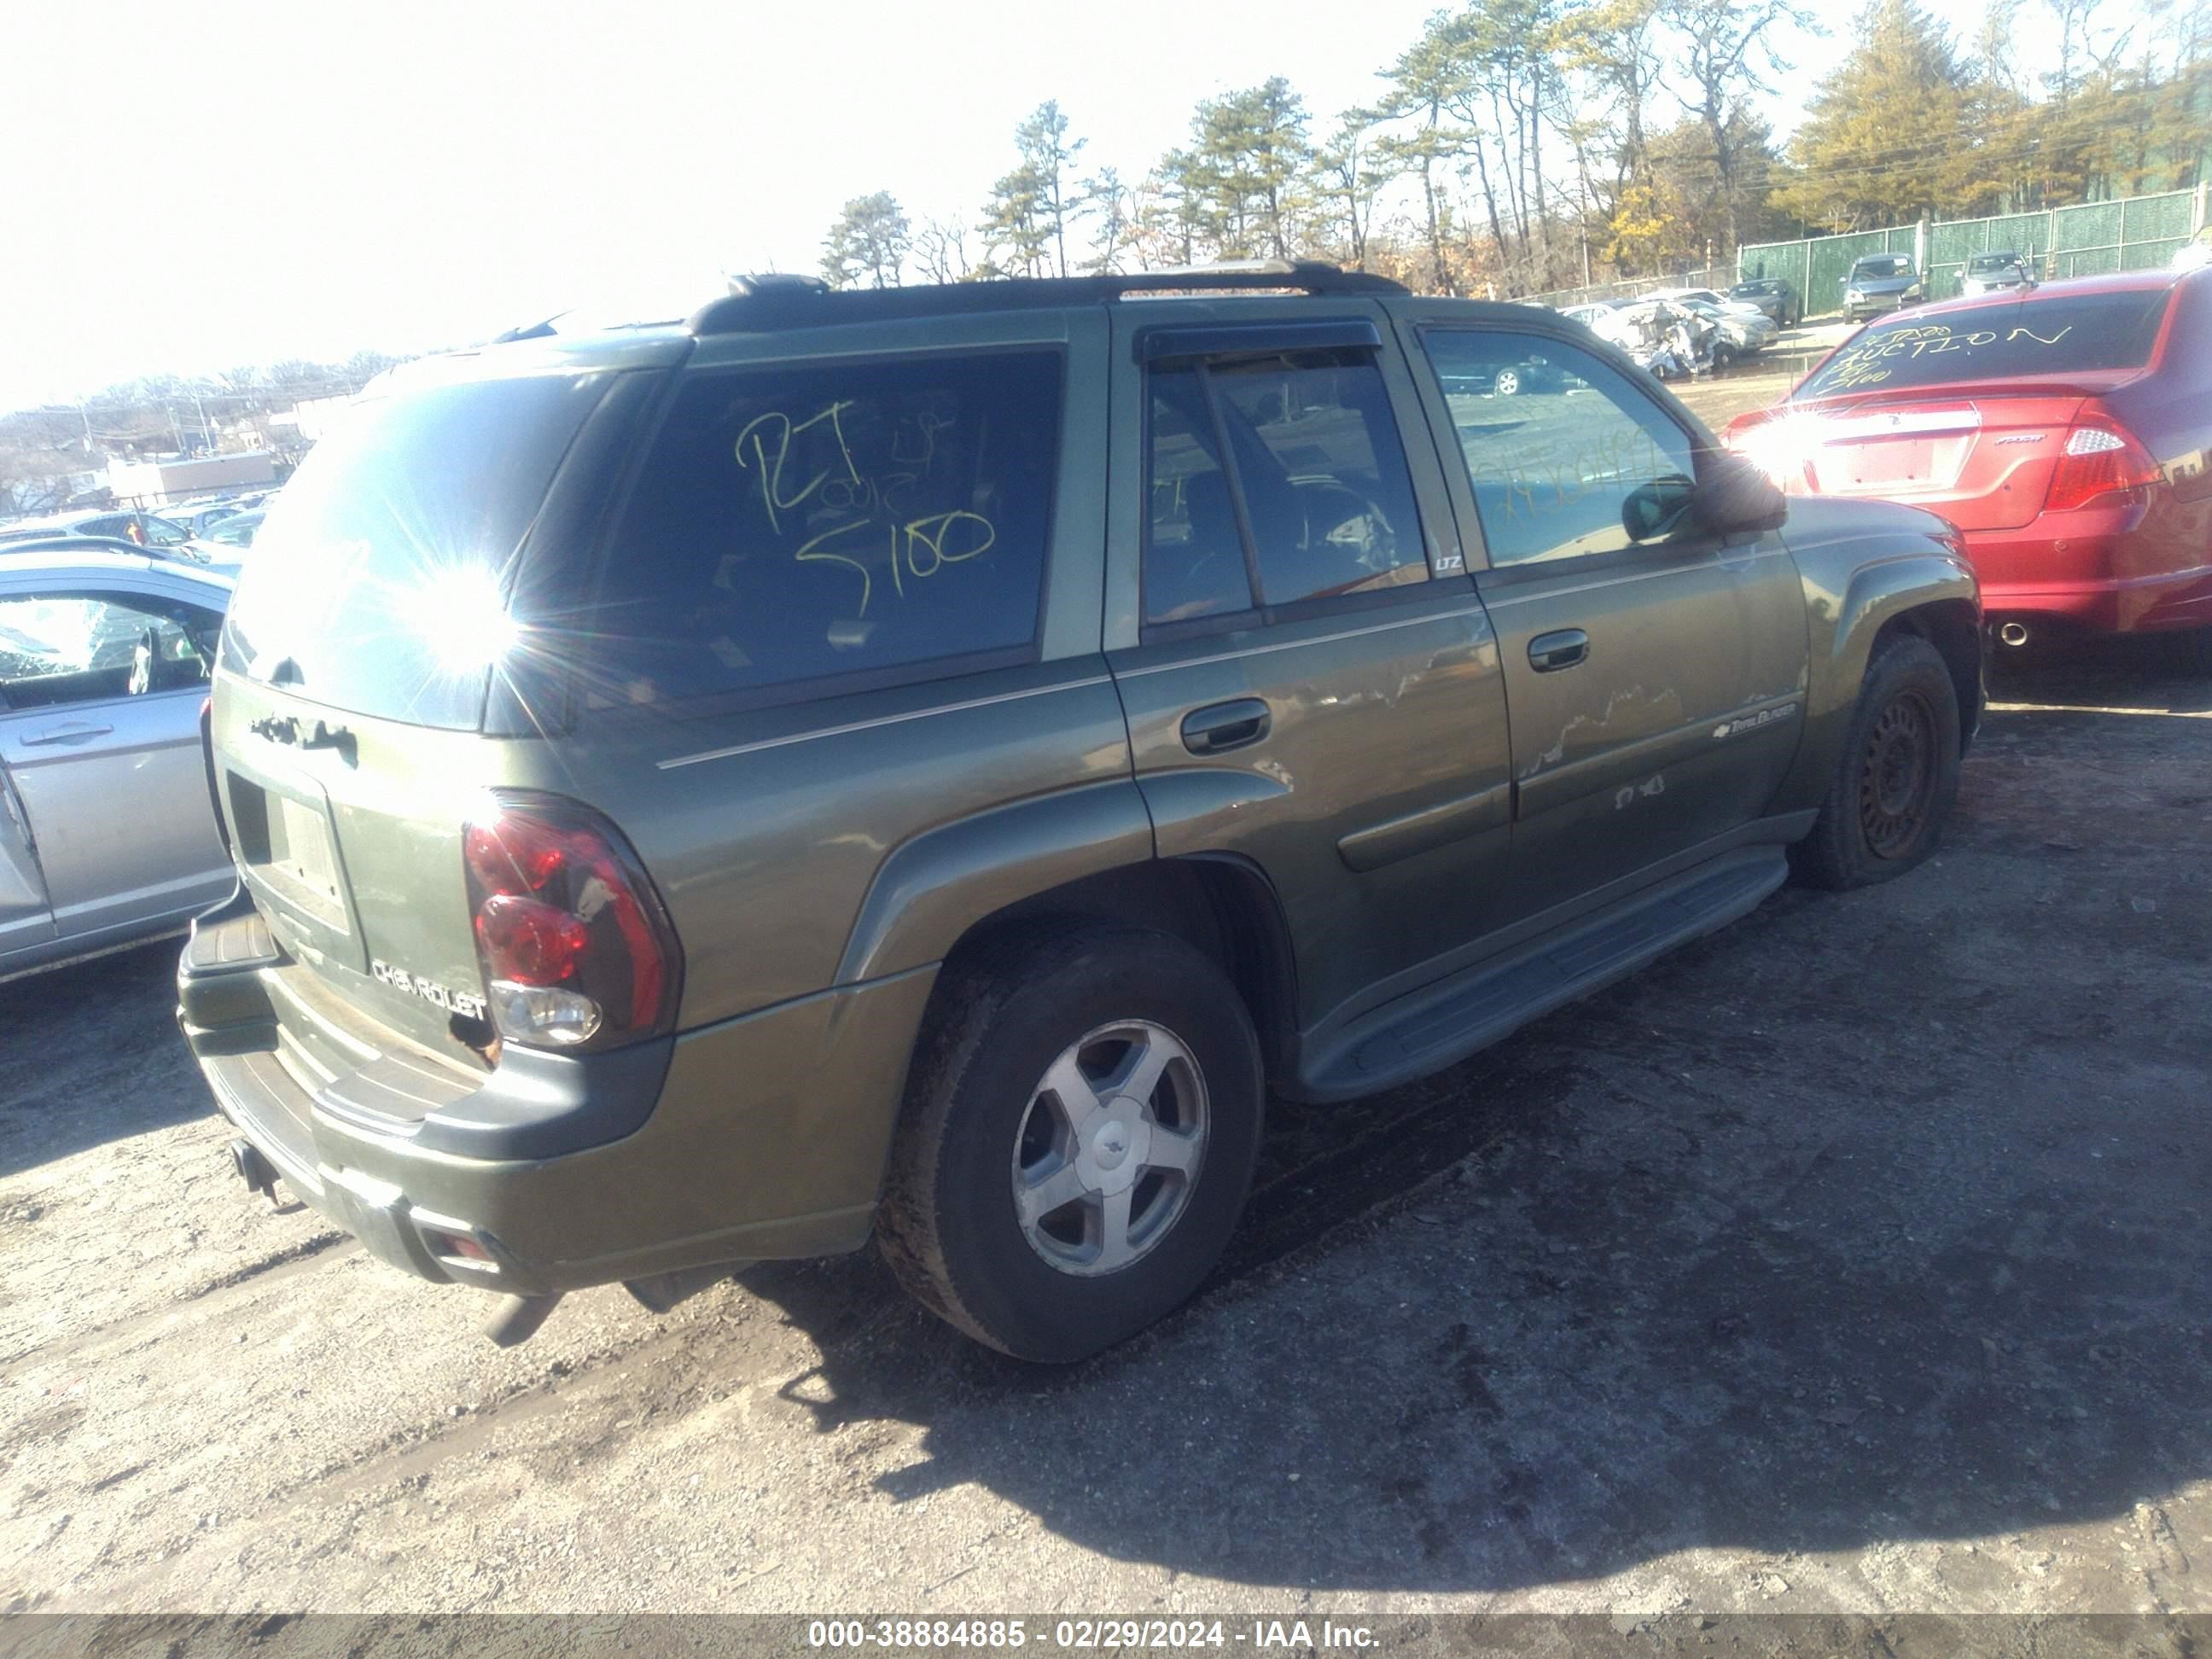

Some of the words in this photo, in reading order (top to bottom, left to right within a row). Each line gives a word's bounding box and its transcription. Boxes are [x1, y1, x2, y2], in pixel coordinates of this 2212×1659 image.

[795, 509, 995, 617] 5100
[1435, 556, 1462, 571] LTZ
[372, 958, 488, 1021] CHEVROLET
